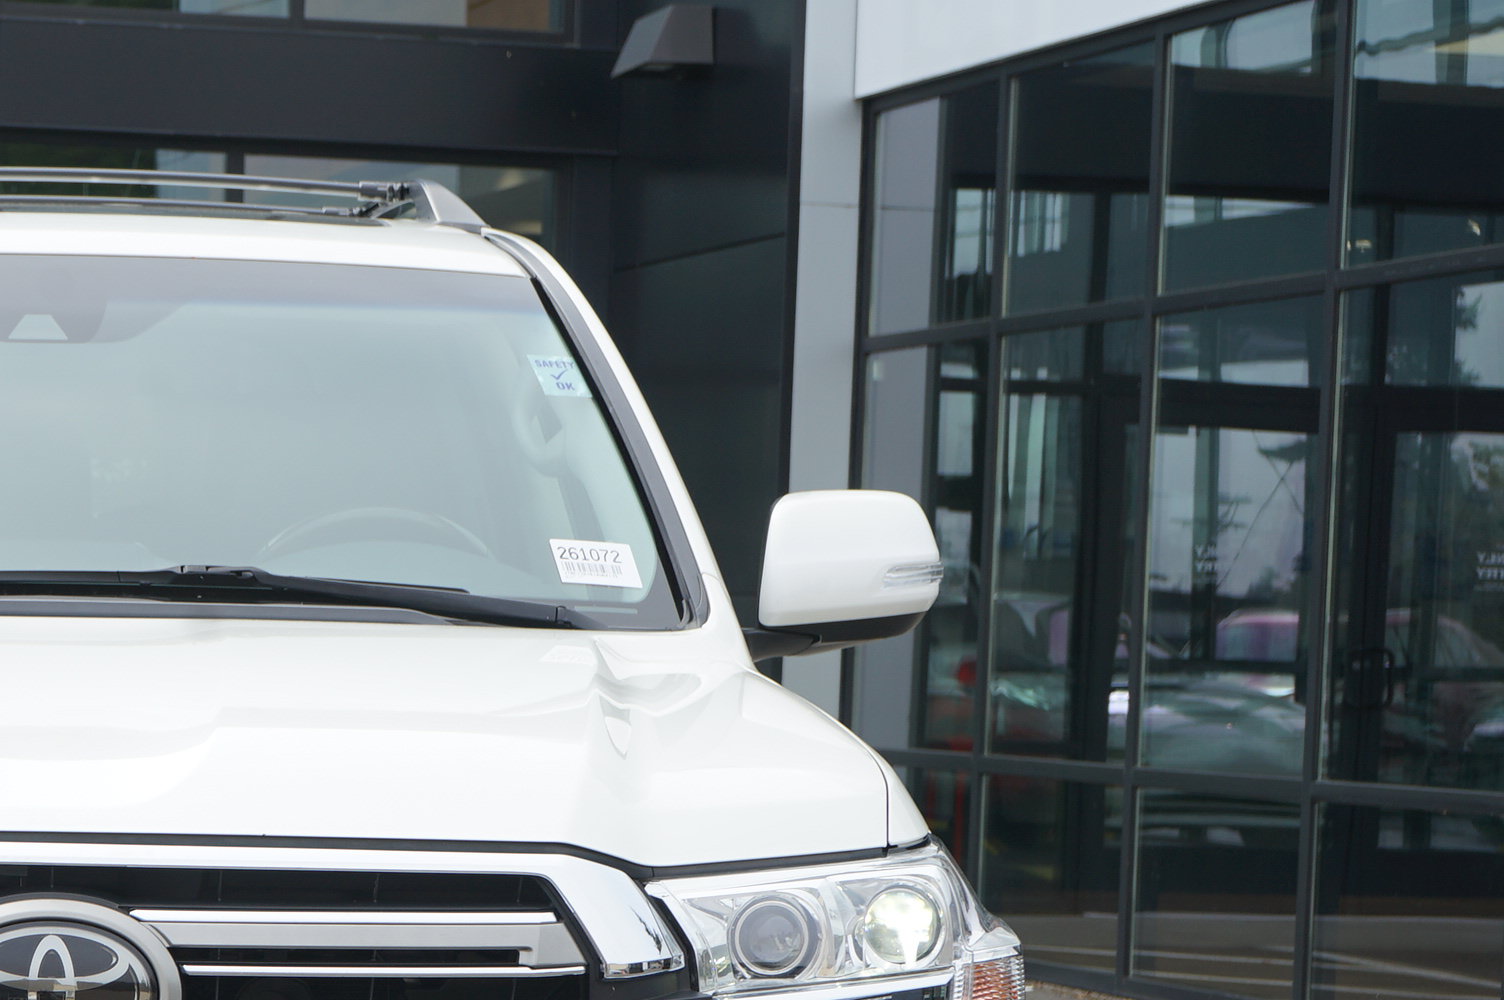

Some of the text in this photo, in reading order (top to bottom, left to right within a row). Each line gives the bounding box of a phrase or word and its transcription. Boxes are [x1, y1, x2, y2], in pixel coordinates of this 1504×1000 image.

[534, 359, 575, 369] SAFETY
[556, 382, 575, 391] OK
[557, 546, 623, 564] 261072
